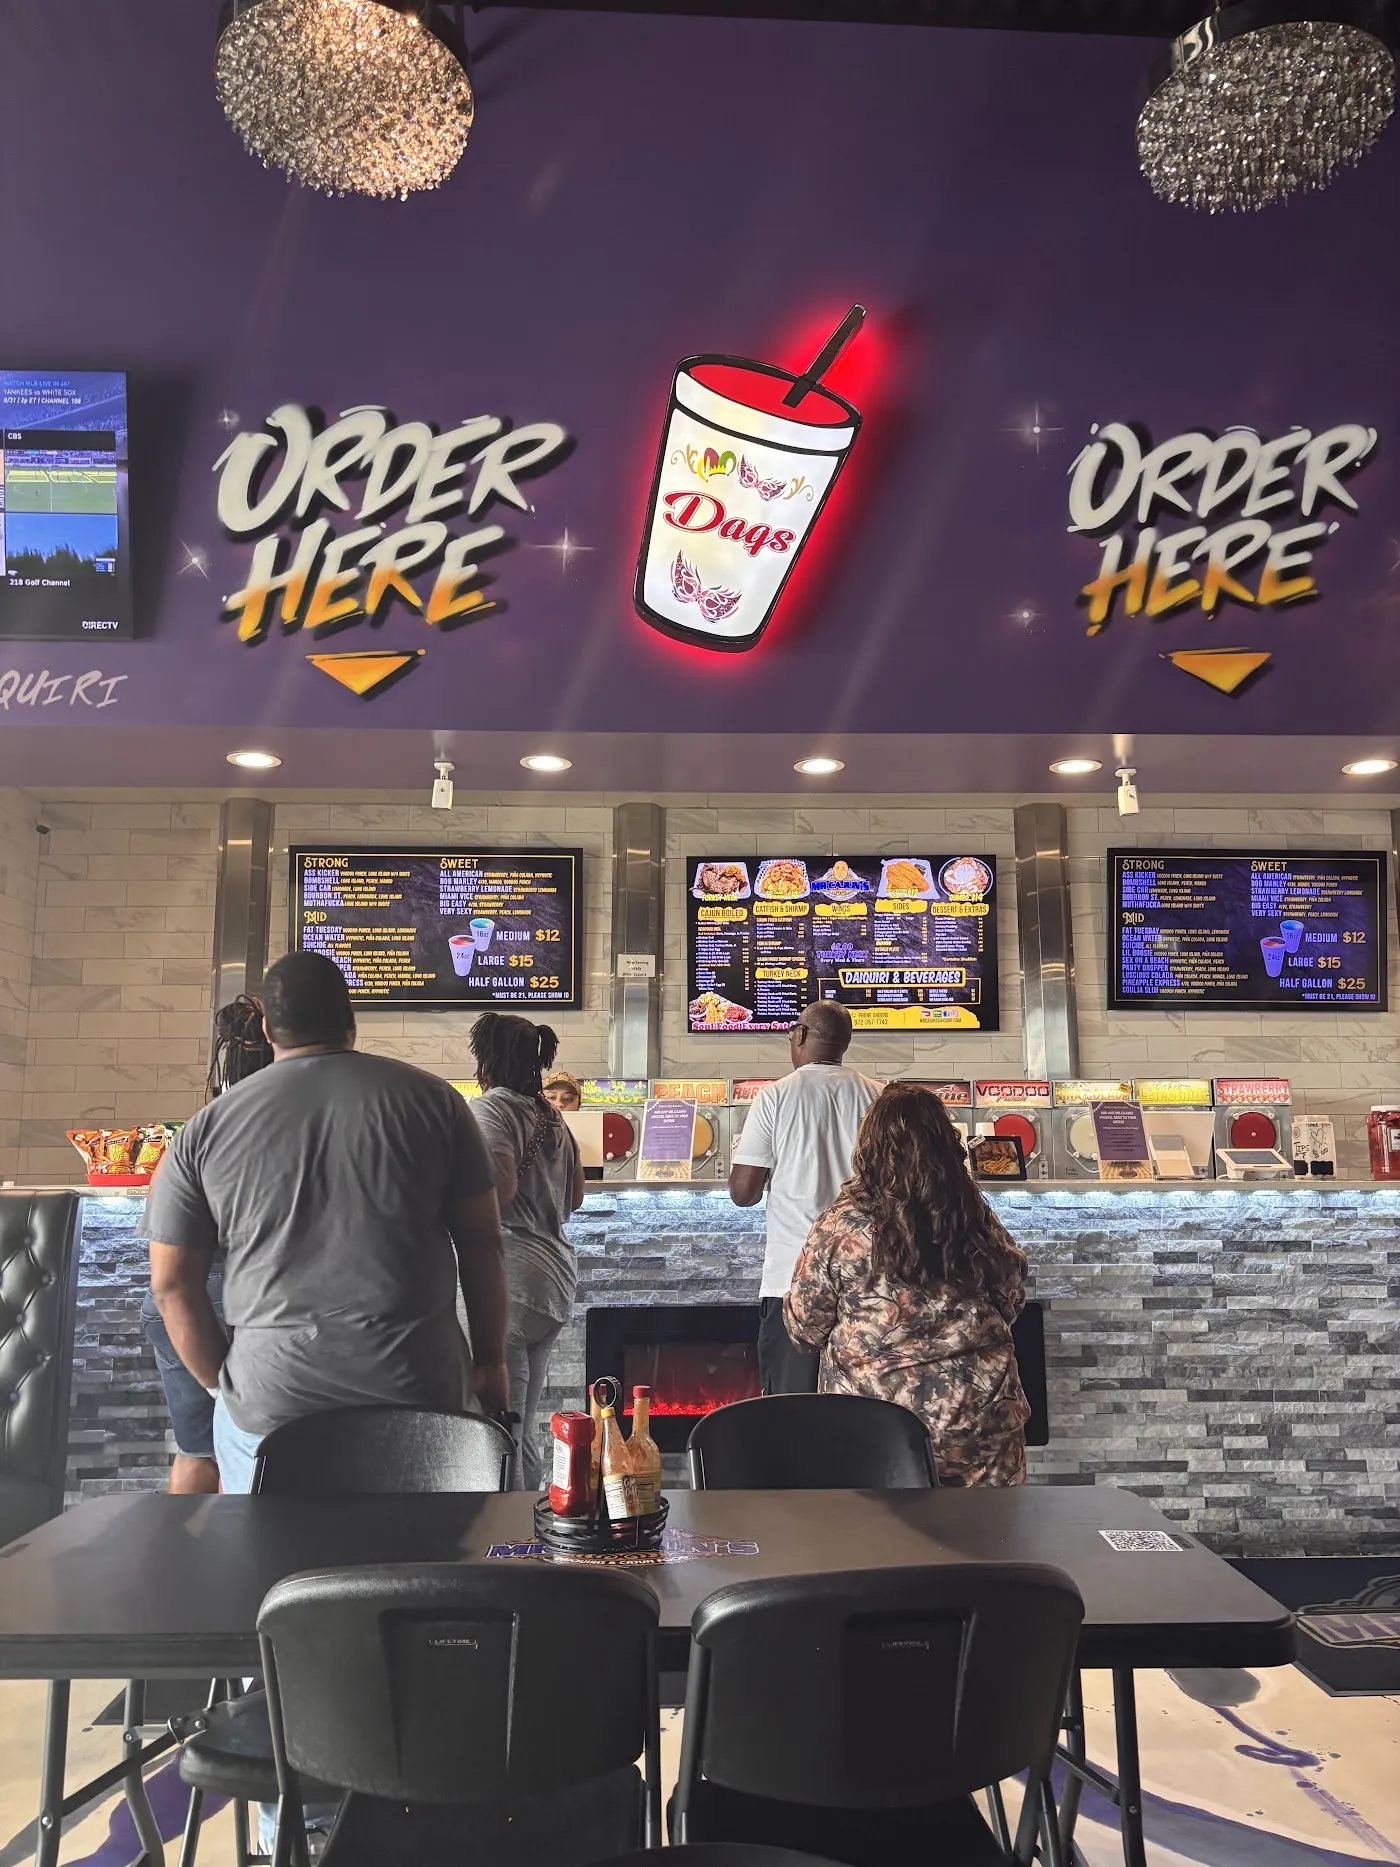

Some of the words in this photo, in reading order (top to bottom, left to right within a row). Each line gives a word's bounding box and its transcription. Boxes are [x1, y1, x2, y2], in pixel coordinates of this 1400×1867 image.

[212, 404, 566, 532] ORDER
[1067, 421, 1378, 533] ORDER
[662, 490, 797, 558] Daqs
[226, 517, 505, 641] HERE
[1081, 518, 1340, 636] HERE
[82, 621, 119, 630] DIRECTV
[304, 857, 349, 868] STRONG
[440, 858, 478, 870] SWEET
[1122, 859, 1164, 870] STRONG
[1250, 860, 1288, 872] SWEET
[304, 869, 316, 877] ASS
[318, 869, 340, 877] KICKER
[832, 905, 850, 913] WINGS
[932, 906, 957, 914] DESSERT
[964, 906, 986, 914] EXTRAS
[496, 930, 530, 941] MEDIUM
[536, 928, 560, 942] $12
[1305, 932, 1338, 943] MEDIUM
[1342, 931, 1366, 944] $12
[478, 956, 504, 966] LARGE
[508, 954, 534, 968] $15
[1288, 957, 1314, 967] LARGE
[1318, 956, 1341, 969] $15
[468, 977, 490, 987] HALF
[492, 977, 524, 987] GALLON
[530, 976, 560, 988] $25
[845, 972, 890, 984] DAIQUIRI
[892, 972, 901, 984] &
[904, 972, 961, 984] BEVERAGES
[1280, 978, 1300, 988] HALF
[1302, 978, 1332, 988] GALLON
[1337, 977, 1366, 990] $25
[692, 1022, 713, 1030] Soul
[716, 1022, 740, 1030] Food
[742, 1022, 770, 1030] Every
[654, 1082, 727, 1103] PEACH
[976, 1086, 1050, 1096] VOODOO
[1217, 1080, 1290, 1095] STRAWBERRY
[1138, 1088, 1209, 1102] LEMONADE
[619, 1557, 655, 1565] CAJUN
